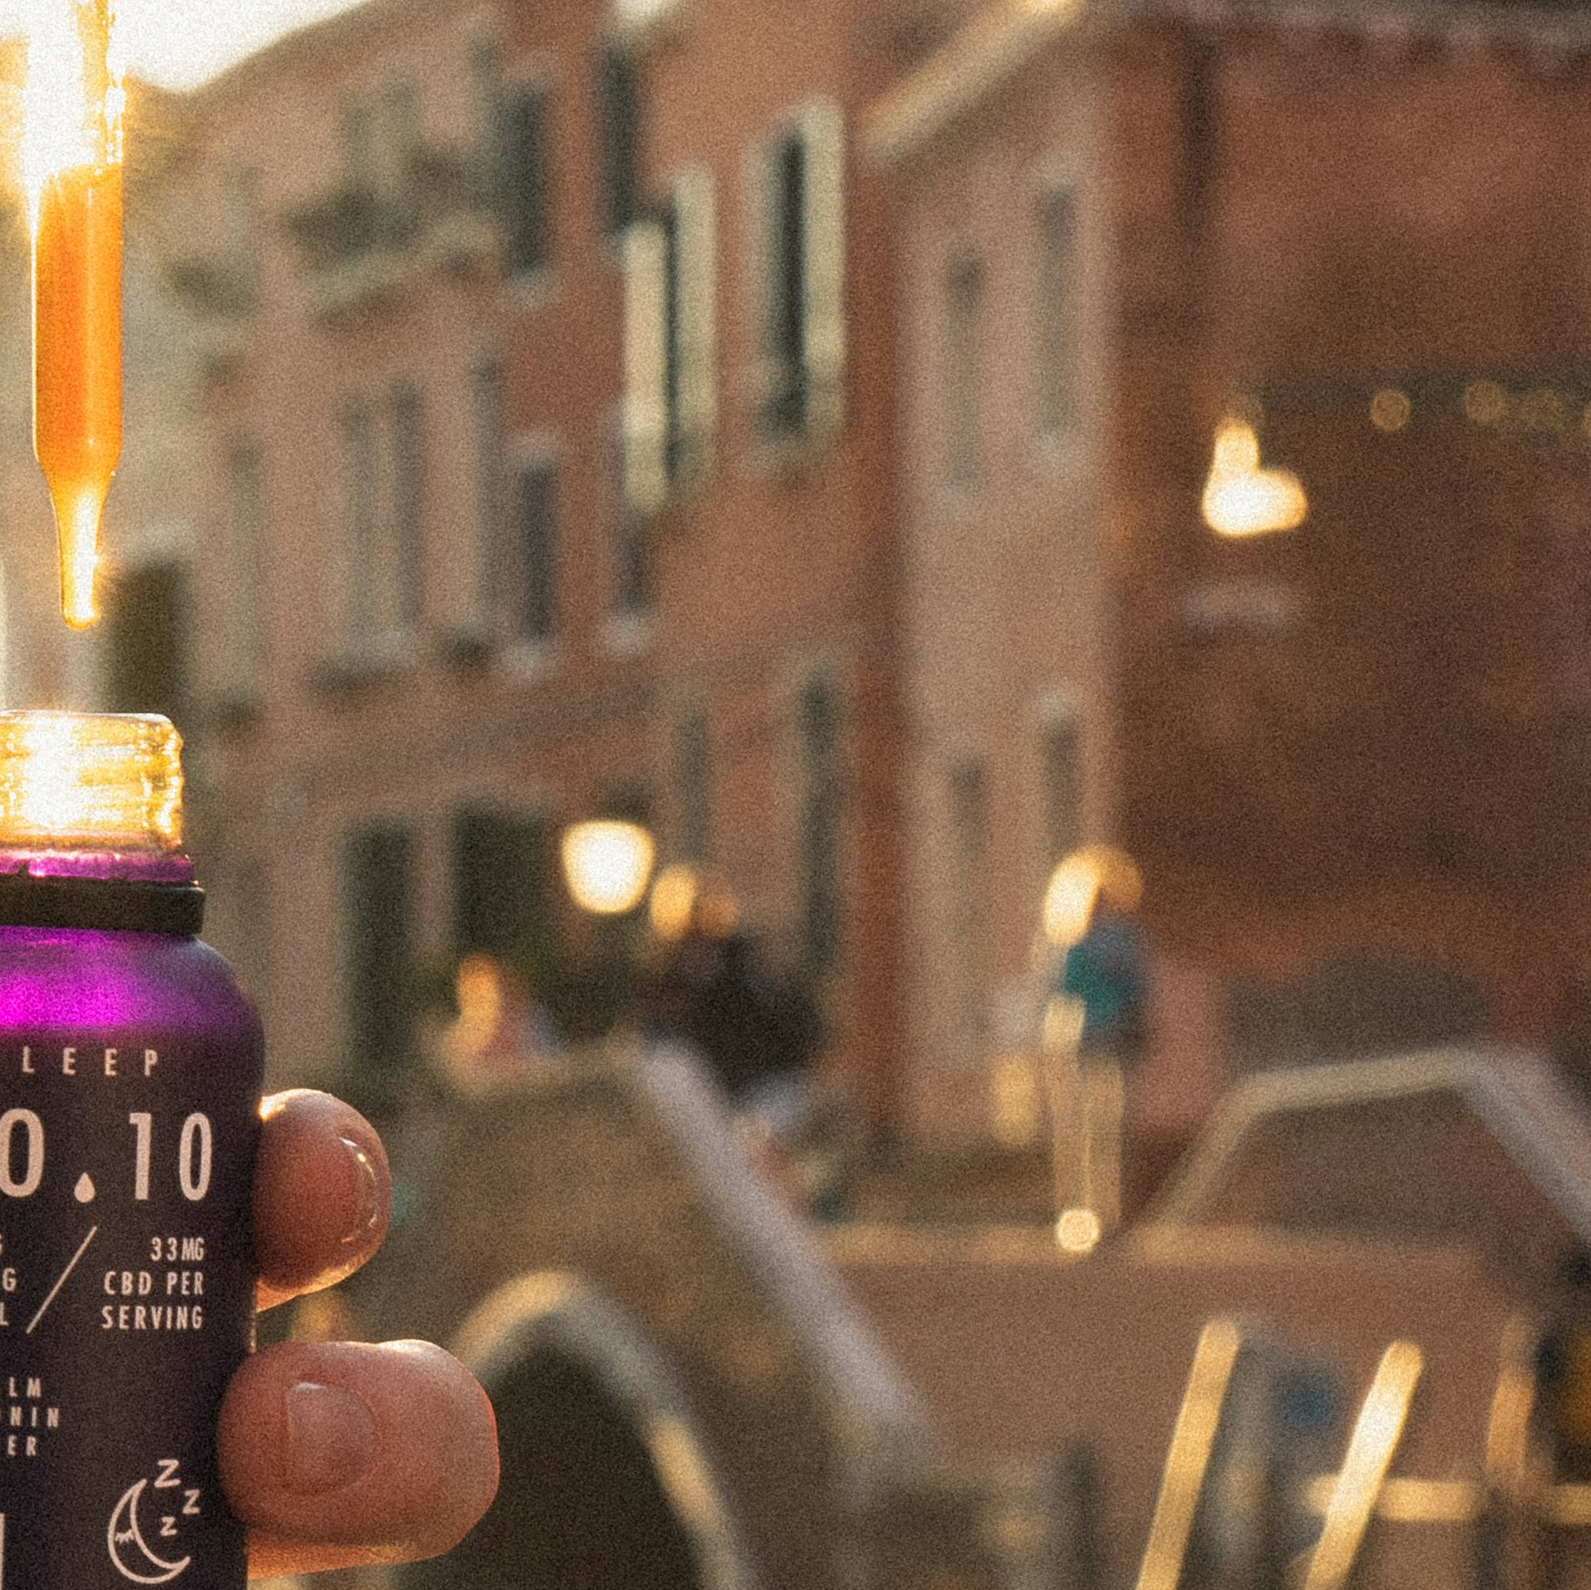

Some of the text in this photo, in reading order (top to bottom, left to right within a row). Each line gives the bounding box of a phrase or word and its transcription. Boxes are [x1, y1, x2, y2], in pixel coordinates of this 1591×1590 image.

[150, 1236, 205, 1261] 33MG
[103, 1270, 204, 1296] CBD PER
[100, 1305, 203, 1330] SERVING
